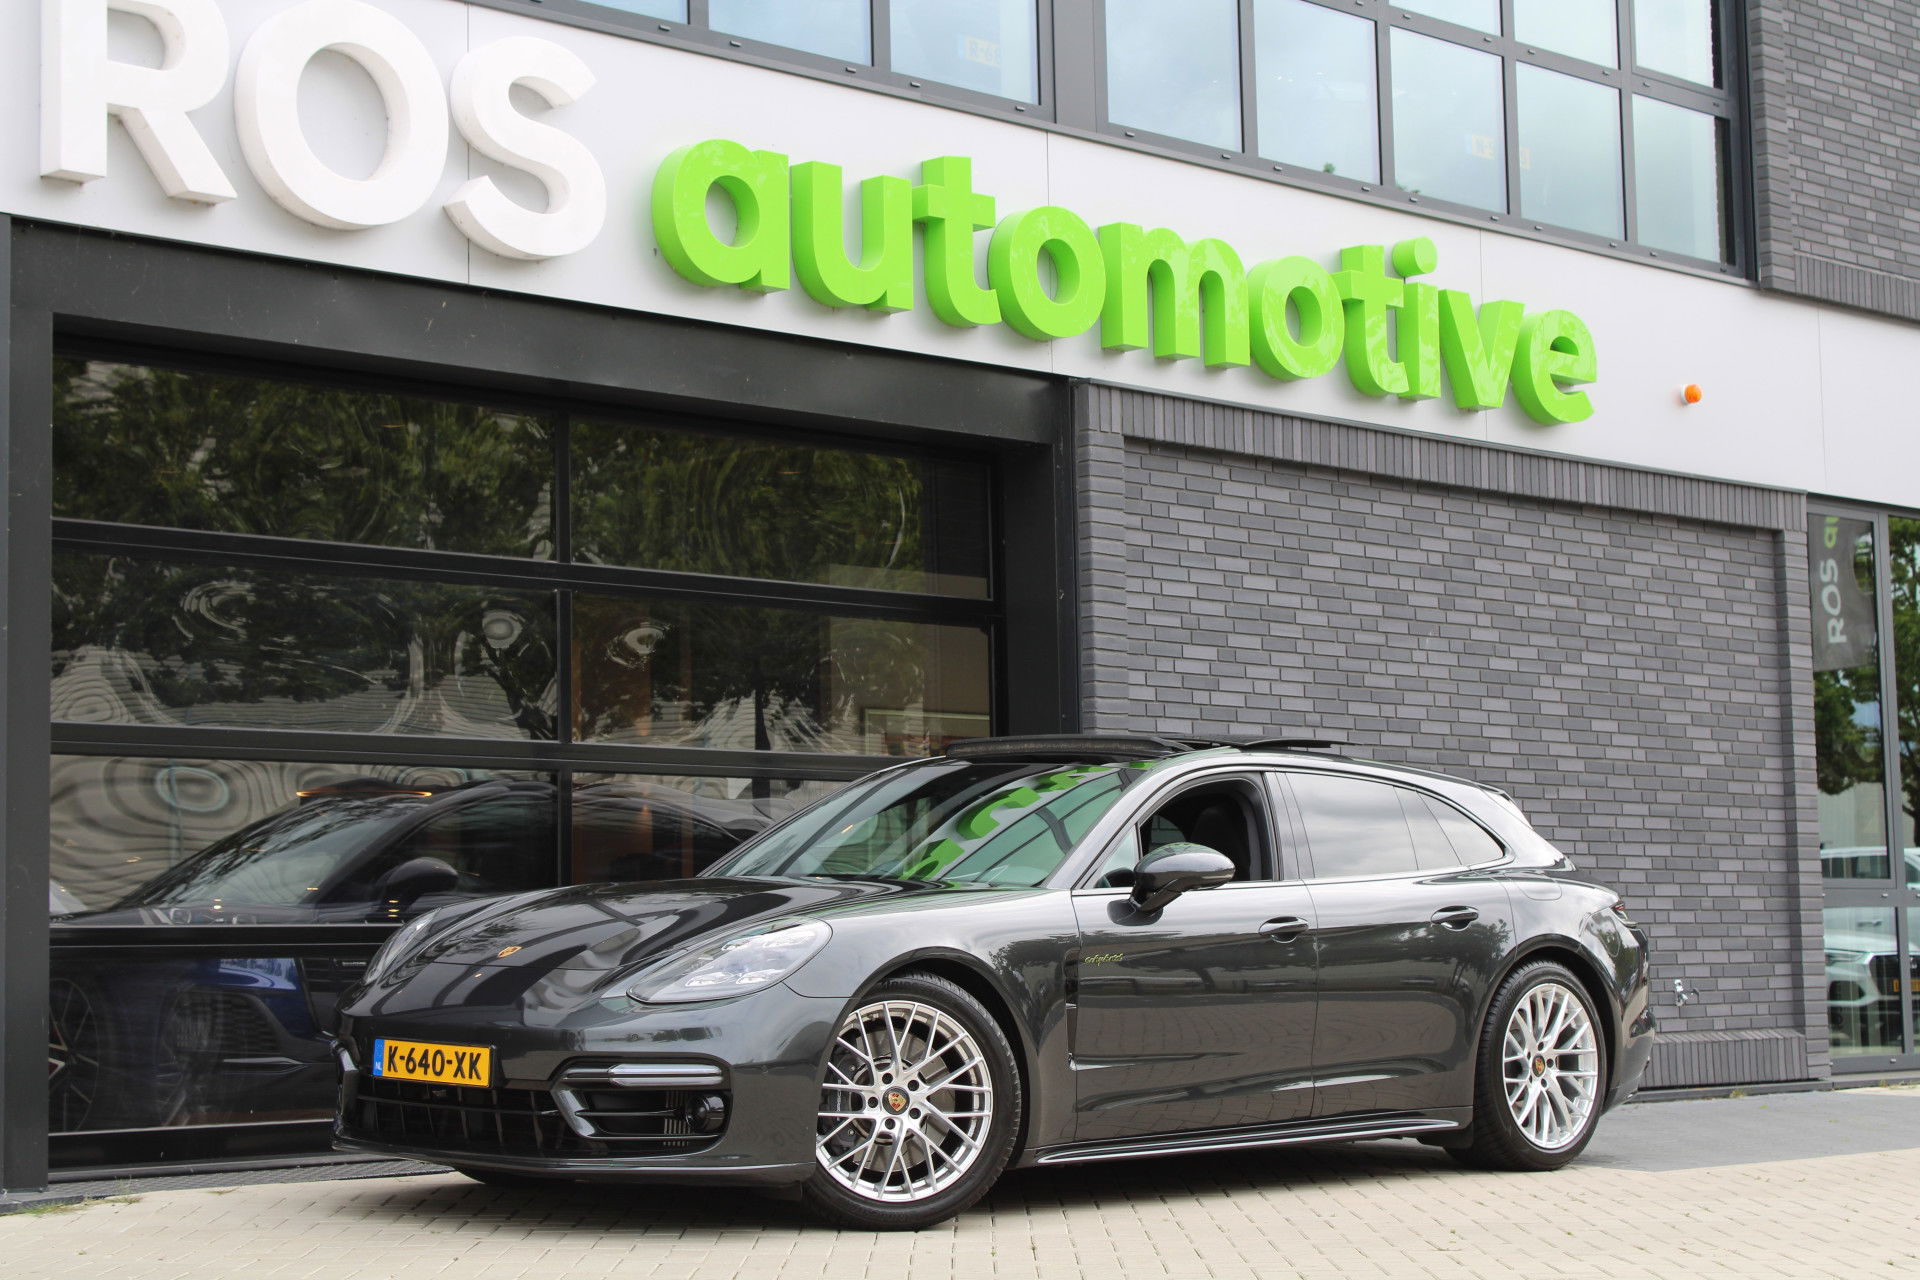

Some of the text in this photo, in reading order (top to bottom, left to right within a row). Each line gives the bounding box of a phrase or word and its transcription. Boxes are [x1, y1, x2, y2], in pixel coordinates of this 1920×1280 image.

[40, 0, 1598, 426] ROS automotive
[1820, 558, 1847, 644] ROS
[387, 1045, 482, 1081] K-640-XK
